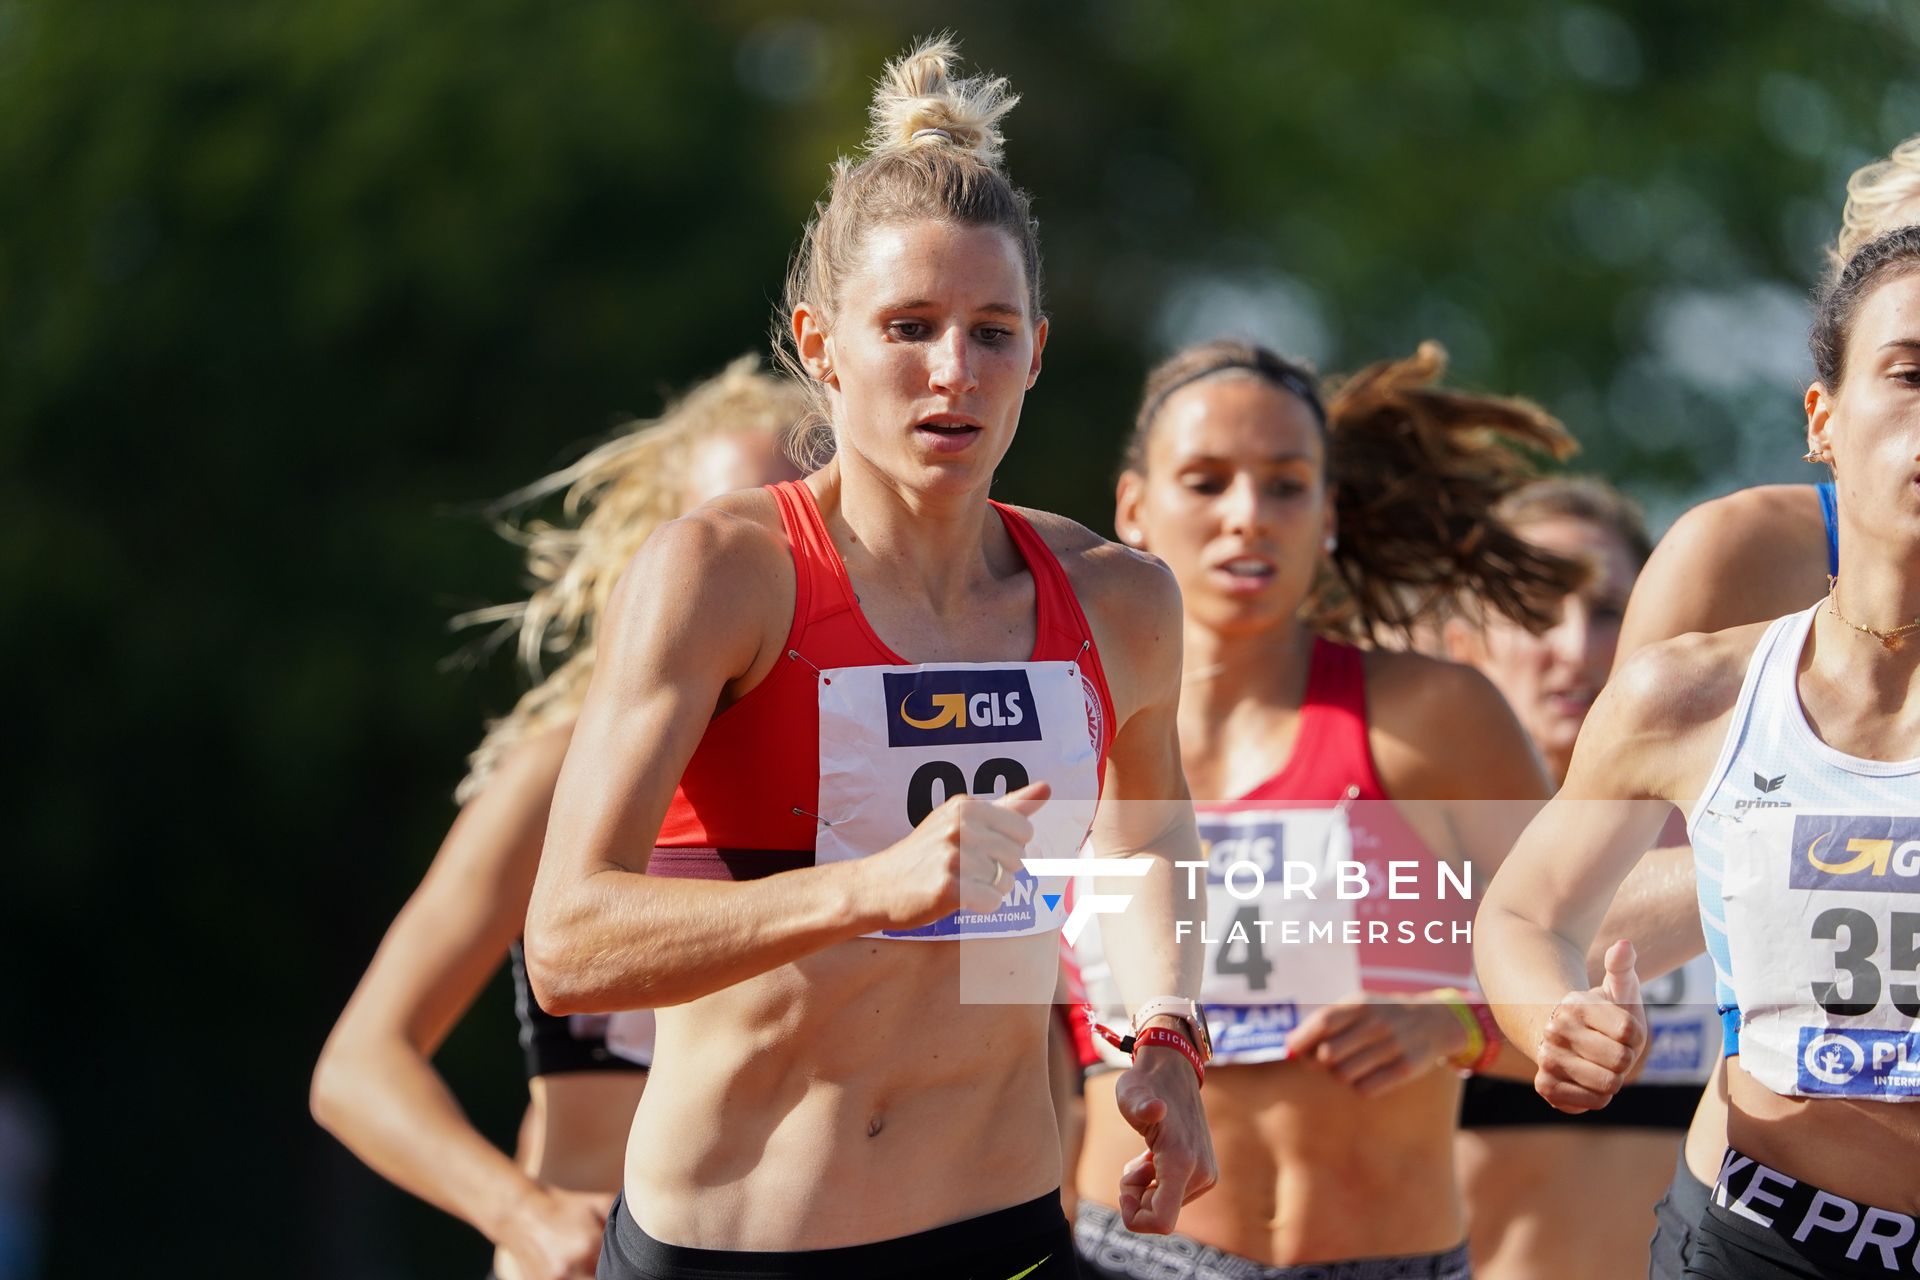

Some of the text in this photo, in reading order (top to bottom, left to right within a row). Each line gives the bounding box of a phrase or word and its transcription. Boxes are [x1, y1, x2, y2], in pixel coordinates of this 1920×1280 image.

[969, 691, 1023, 727] GLS
[953, 911, 1031, 926] INTERNATIONAL
[1150, 1031, 1205, 1076] LEICHTATH
[1872, 1041, 1920, 1072] PL
[1792, 1189, 1920, 1274] PR
